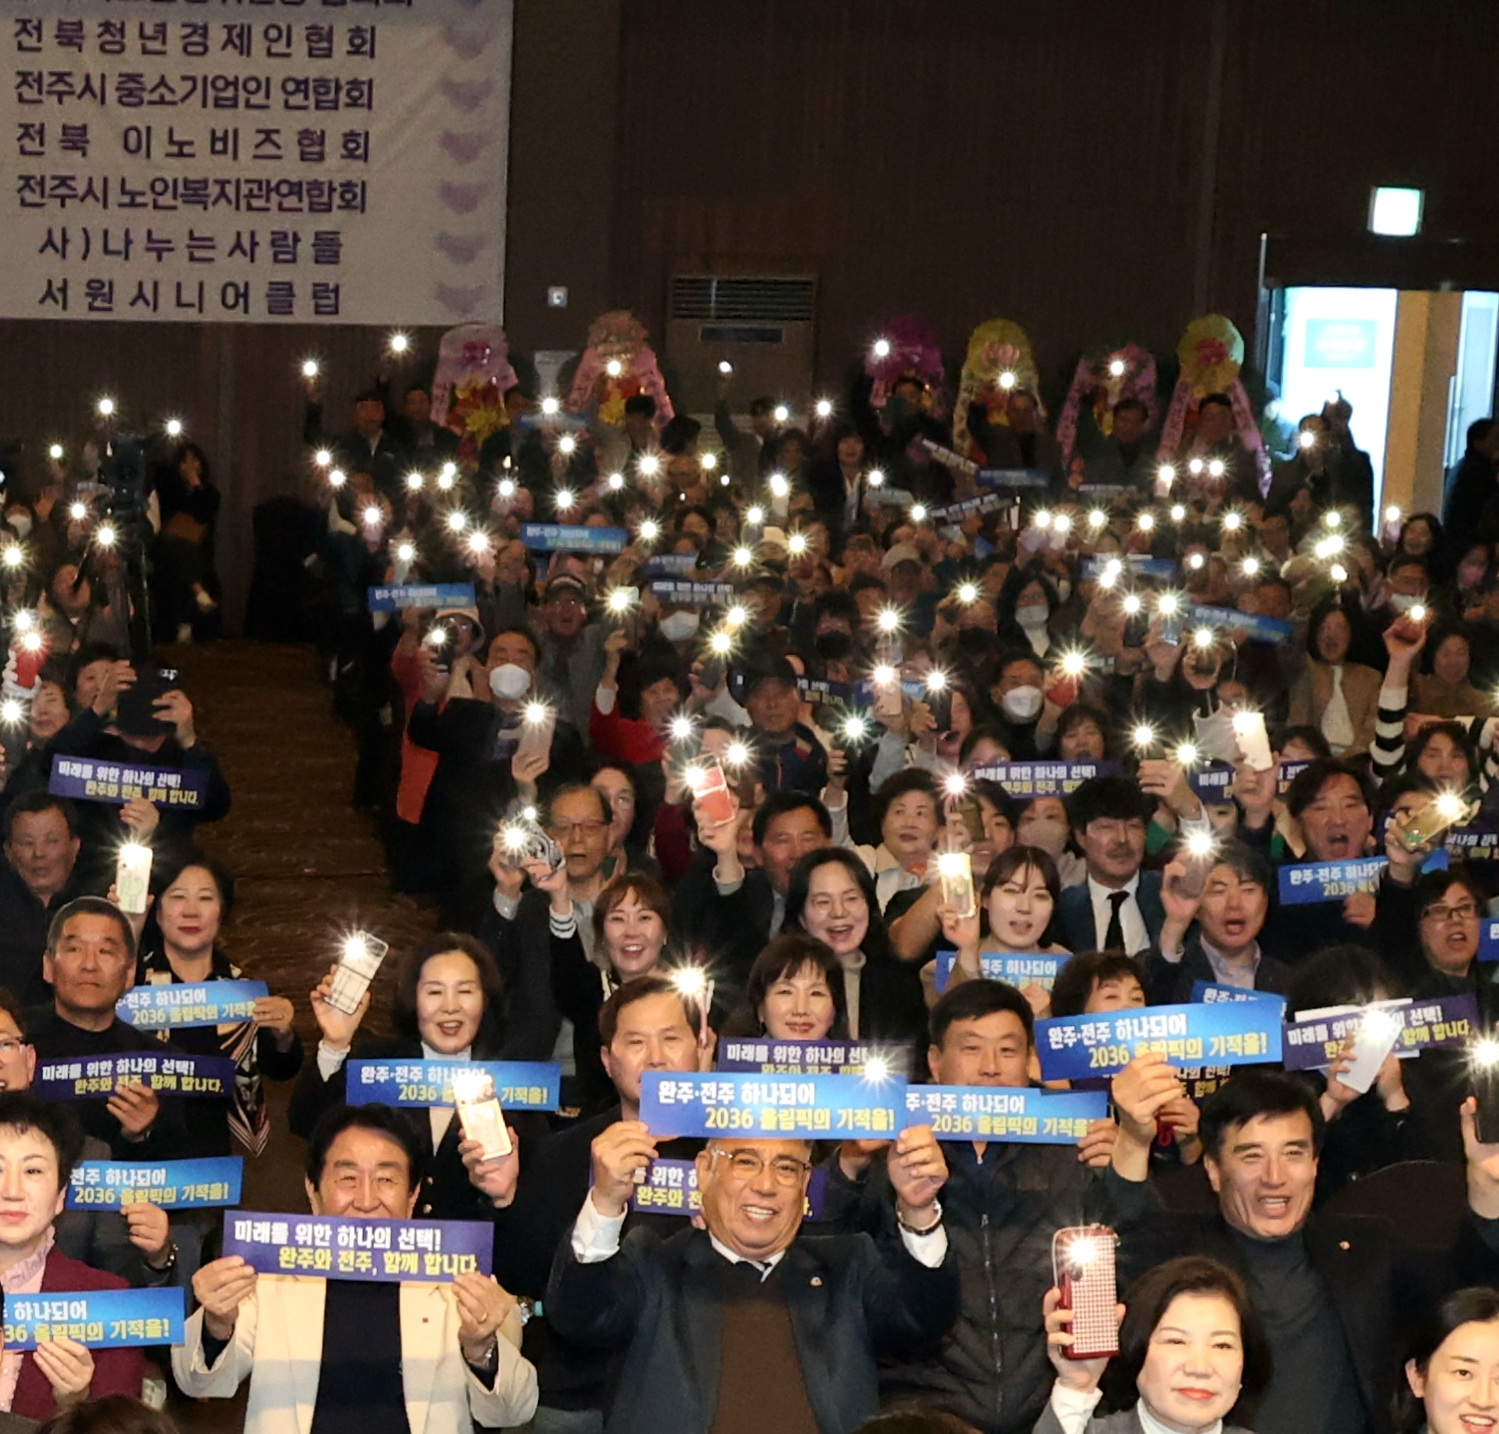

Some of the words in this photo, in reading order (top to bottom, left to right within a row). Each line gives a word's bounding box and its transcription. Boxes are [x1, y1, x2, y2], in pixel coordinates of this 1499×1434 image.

[15, 70, 106, 105] 전주시
[115, 72, 271, 108] 중소기업인
[281, 76, 373, 111] 연합회
[17, 175, 108, 210] 전주시
[118, 176, 366, 214] 노인복지관연합회
[58, 761, 92, 777] 미래를
[96, 763, 119, 780] 위한
[122, 767, 153, 784] 하나의
[155, 988, 206, 1006] 하나되어
[132, 1009, 165, 1025] 2036
[1048, 1023, 1110, 1050] 완주·전주
[1115, 1012, 1187, 1040] 하나되어
[727, 1043, 768, 1062] 미래를
[773, 1045, 801, 1064] 위한
[805, 1045, 845, 1065] 하나의
[1089, 1045, 1129, 1069] 2036
[1209, 1031, 1267, 1057] 기적을!
[41, 1063, 81, 1081] 미래를
[86, 1061, 112, 1078] 위한
[117, 1057, 156, 1075] 하나의
[161, 1059, 194, 1076] 선택!
[361, 1065, 422, 1083] 완주·전주
[74, 1078, 112, 1095] 완주와
[149, 1076, 177, 1091] 함께
[181, 1076, 223, 1094] 합니다.
[398, 1083, 435, 1101] 2036
[500, 1086, 546, 1104] 기적을!
[658, 1081, 736, 1104] 완주·전주
[741, 1082, 815, 1105] 하나되어
[963, 1094, 1025, 1113] 하나되어
[705, 1108, 753, 1128] 2036
[759, 1107, 827, 1130] 올림픽의
[836, 1108, 894, 1131] 기적을!
[931, 1114, 972, 1133] 2036
[978, 1116, 1037, 1136] 올림픽의
[105, 1167, 166, 1185] 하나되어
[651, 1167, 683, 1187] 위한
[74, 1186, 114, 1203] 2036
[180, 1183, 228, 1201] 기적을!
[637, 1186, 684, 1207] 완주와
[234, 1220, 288, 1243] 미래를
[295, 1222, 332, 1245] 위한
[340, 1224, 390, 1248] 하나의
[399, 1227, 441, 1250] 선택!
[278, 1246, 332, 1269] 완주와
[337, 1248, 377, 1275] 전주,
[382, 1249, 419, 1271] 함께
[14, 1300, 88, 1321] 하나되어
[110, 1318, 170, 1340] 기적을!
